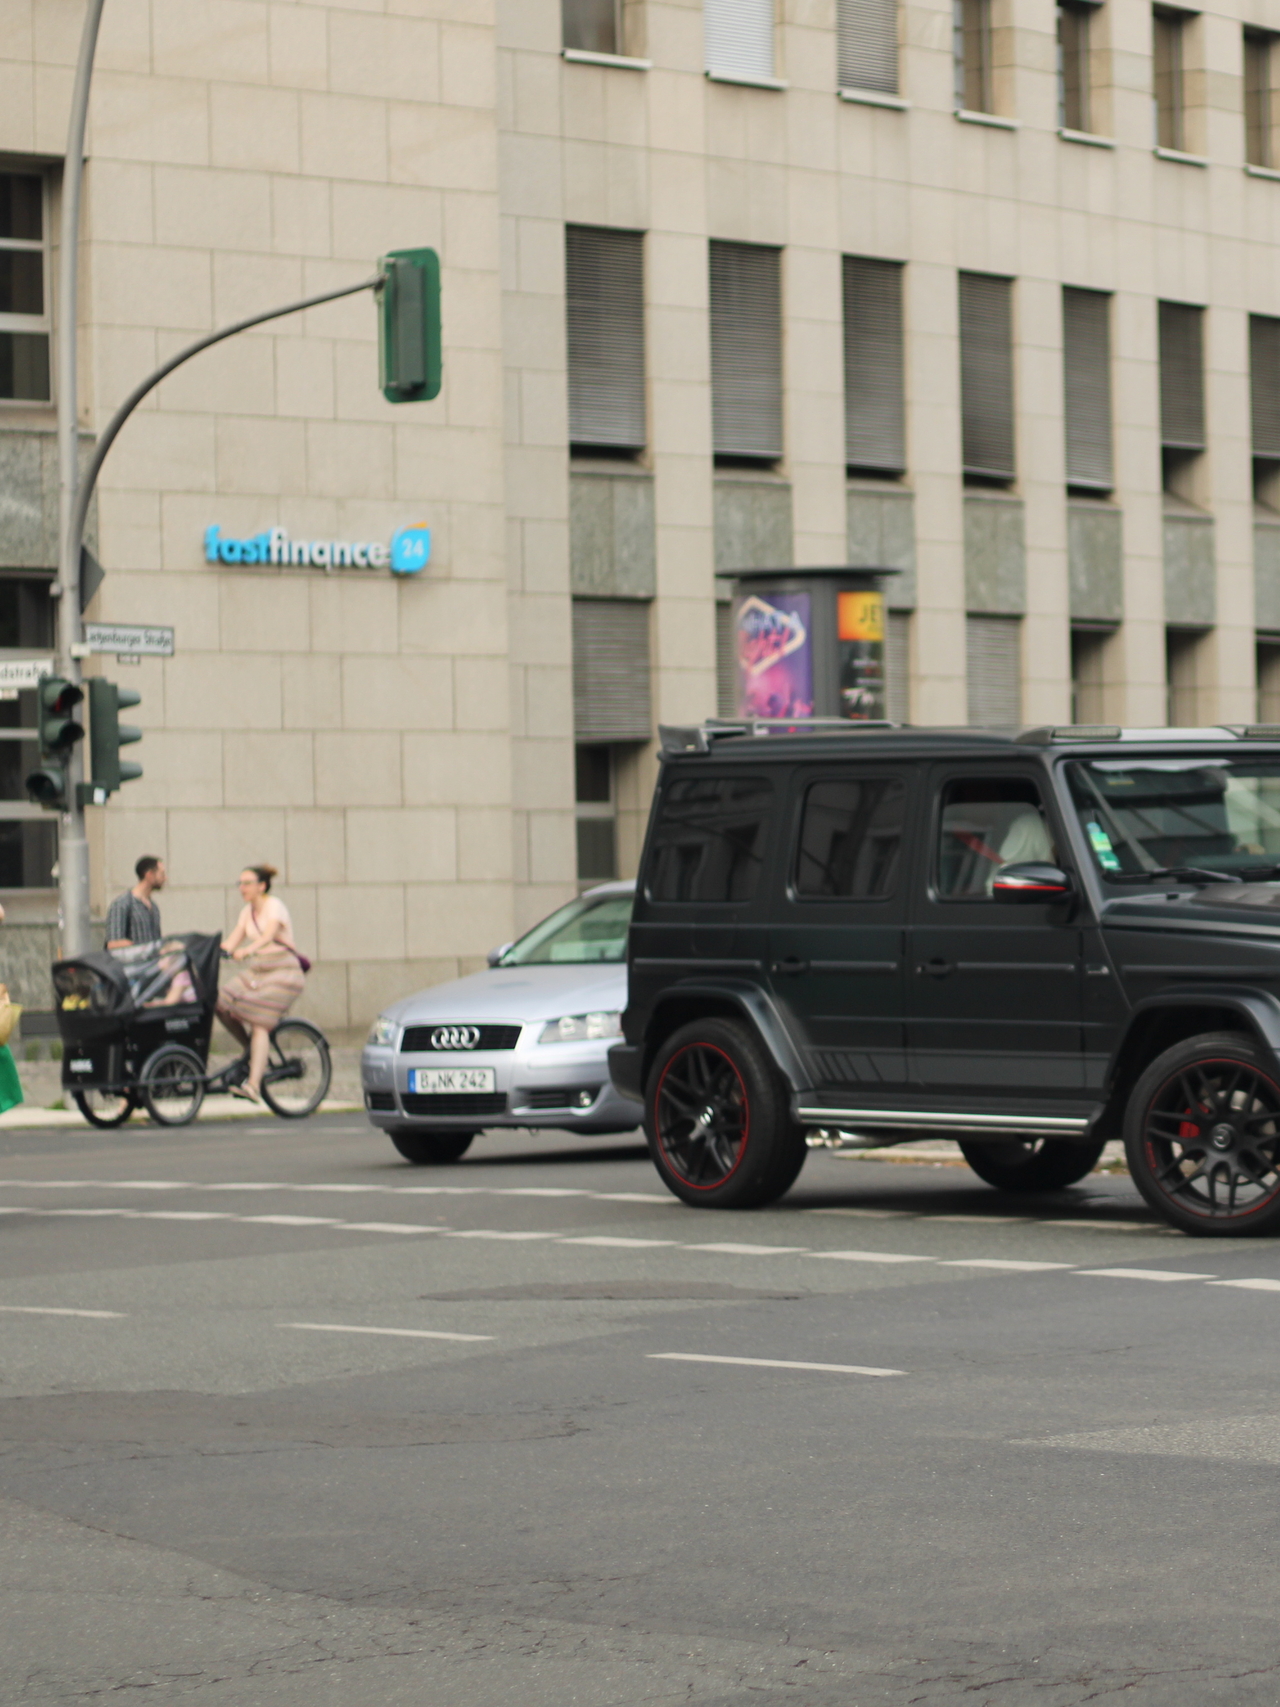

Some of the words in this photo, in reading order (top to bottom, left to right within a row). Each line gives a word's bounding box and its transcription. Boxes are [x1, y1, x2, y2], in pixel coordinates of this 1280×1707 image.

[402, 538, 425, 558] 24
[420, 1071, 429, 1089] B
[438, 1071, 456, 1089] NK
[459, 1071, 487, 1089] 242
